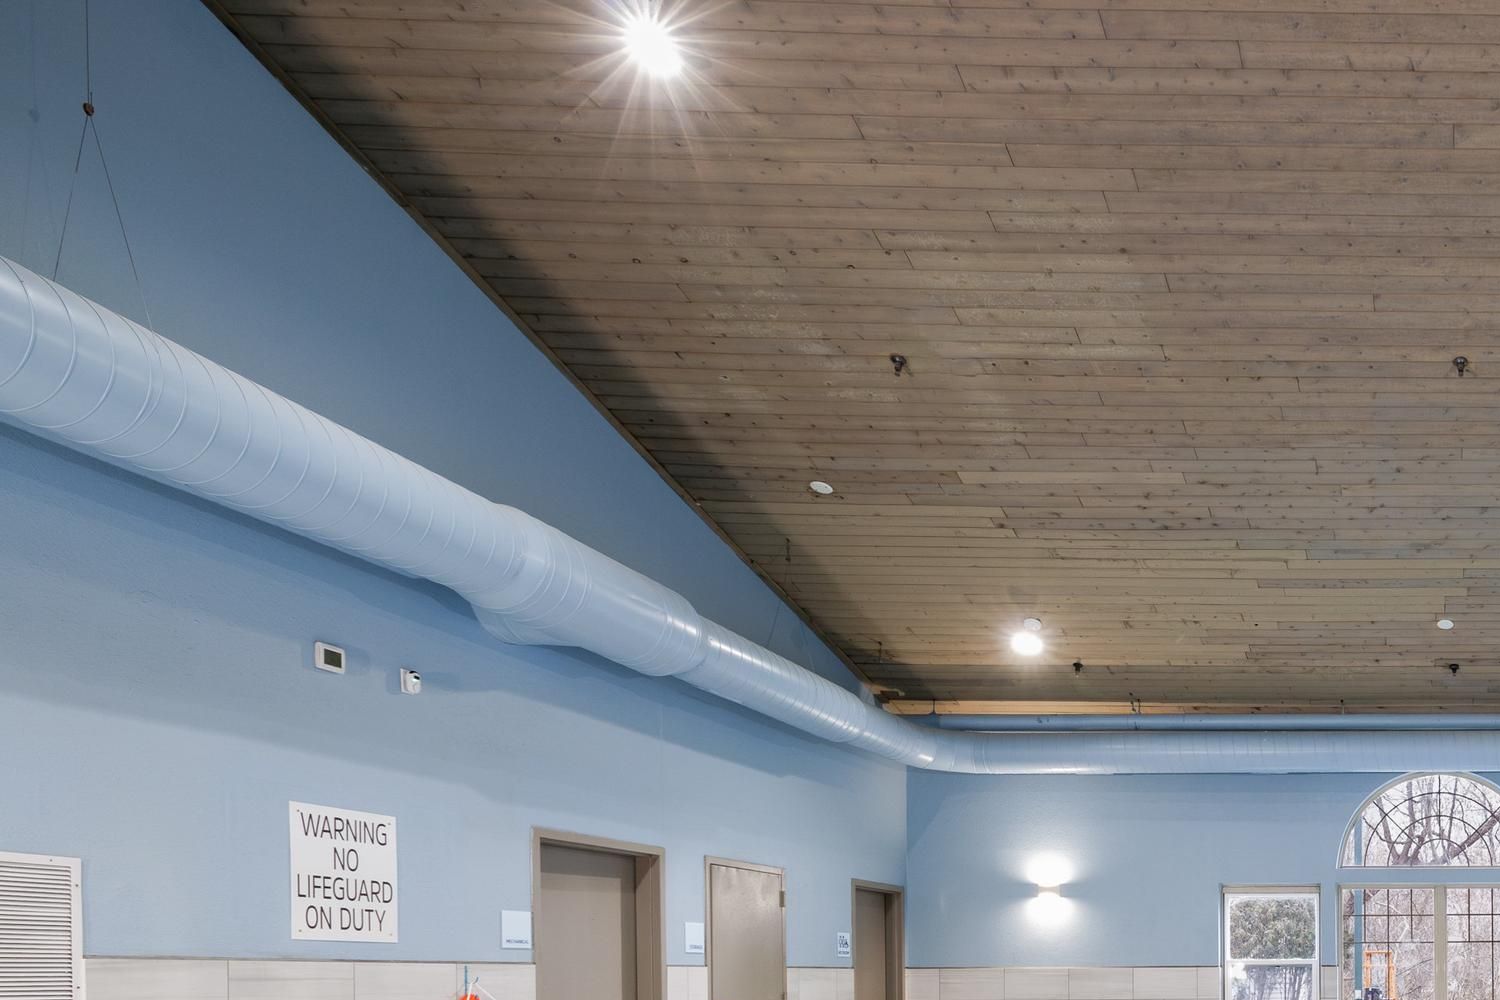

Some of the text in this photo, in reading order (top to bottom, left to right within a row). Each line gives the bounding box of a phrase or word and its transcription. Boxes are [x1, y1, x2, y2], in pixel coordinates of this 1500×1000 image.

[300, 811, 387, 846] WARNING
[333, 847, 359, 872] NO
[297, 873, 393, 904] LIFEGUARD
[305, 905, 387, 932] ON DUTY
